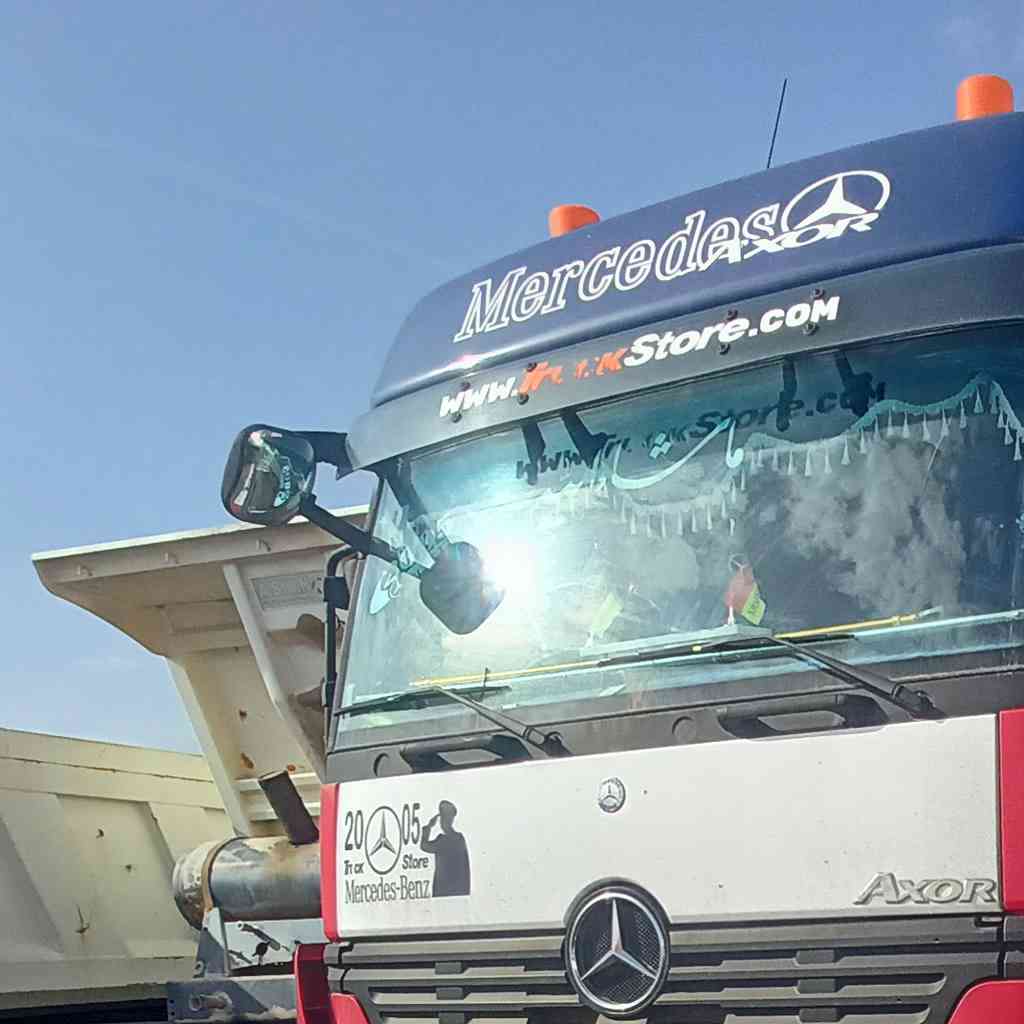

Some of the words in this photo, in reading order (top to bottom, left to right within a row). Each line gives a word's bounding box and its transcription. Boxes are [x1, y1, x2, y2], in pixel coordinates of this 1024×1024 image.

[453, 203, 781, 343] Mercedes
[402, 854, 429, 870] Store
[345, 875, 431, 904] Mercedes-Benz
